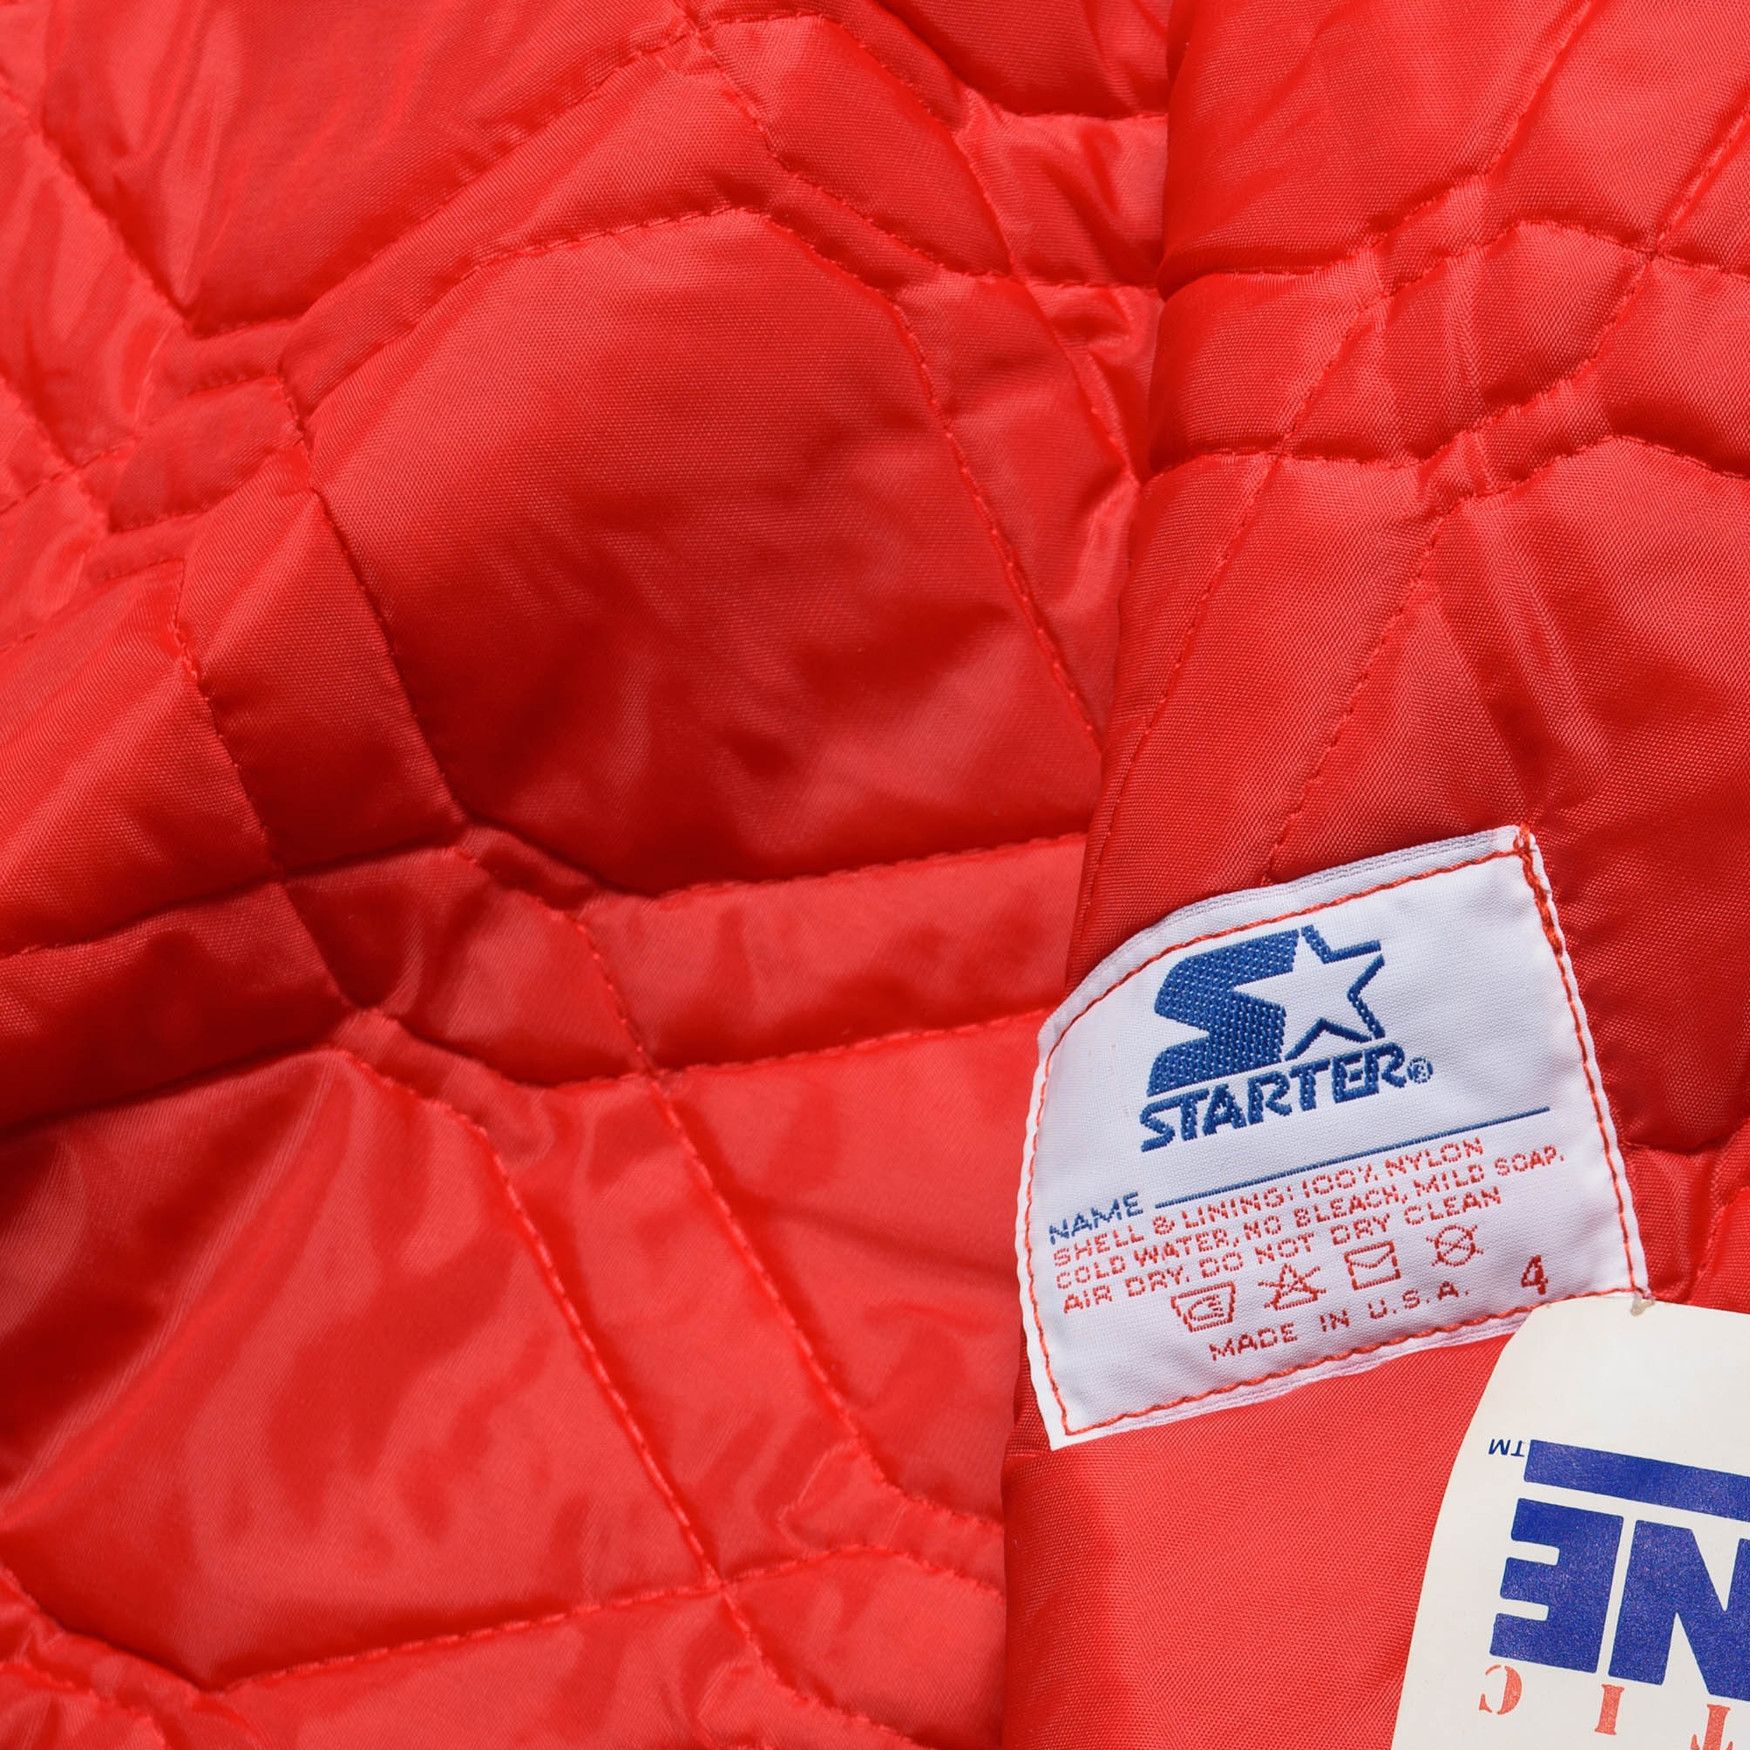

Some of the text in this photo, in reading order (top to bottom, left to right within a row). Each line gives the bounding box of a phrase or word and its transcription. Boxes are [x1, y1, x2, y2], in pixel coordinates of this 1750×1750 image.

[1049, 1192, 1143, 1245] NAME
[1054, 1137, 1484, 1267] SHELL & LINING: 100% NYLON
[1056, 1255, 1126, 1290] COLD
[1134, 1228, 1239, 1267] WATER,
[1244, 1215, 1282, 1241] NO
[1413, 1164, 1485, 1197] MILD
[1063, 1285, 1112, 1314] AIR
[1200, 1251, 1243, 1278] DO
[1254, 1232, 1315, 1265] NOT
[1330, 1212, 1390, 1246] DRY
[1404, 1186, 1502, 1225] CLEAN
[1209, 1281, 1469, 1361] MADE IN U.S.A.
[1521, 1254, 1548, 1295] 4
